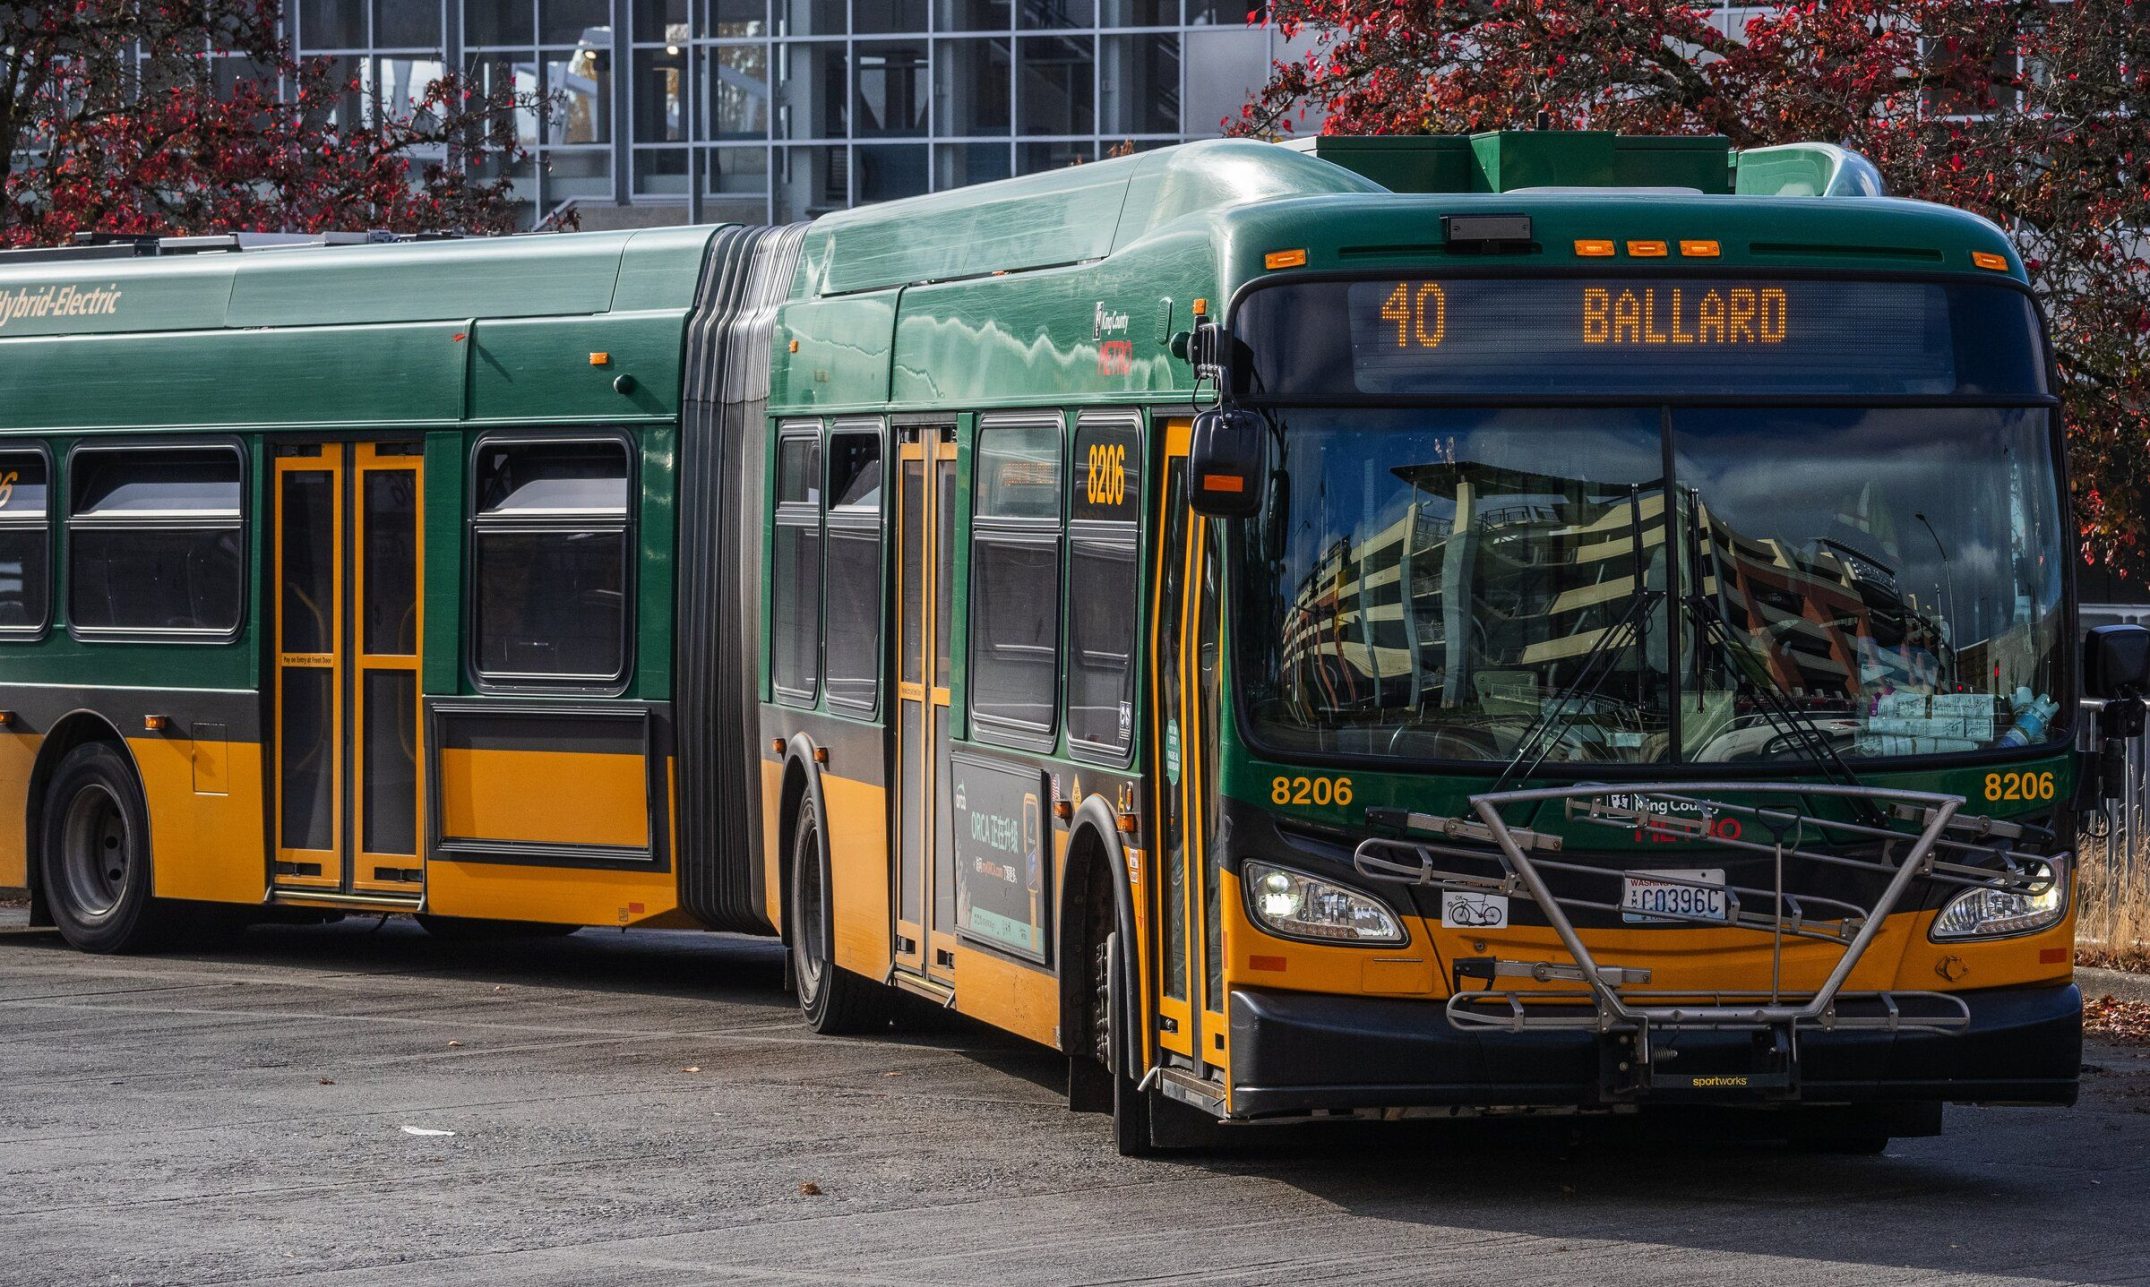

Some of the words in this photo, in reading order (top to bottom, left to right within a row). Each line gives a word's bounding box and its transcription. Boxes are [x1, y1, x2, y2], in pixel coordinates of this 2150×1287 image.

[1381, 282, 1445, 347] 40
[1584, 288, 1786, 343] BALLARD
[1087, 444, 1125, 506] 8206
[1271, 776, 1353, 806] 8206
[1984, 771, 2055, 801] 8206
[971, 811, 990, 844] ORCA
[991, 814, 1018, 854] 正在升级
[1692, 1076, 1747, 1087] sportworks
